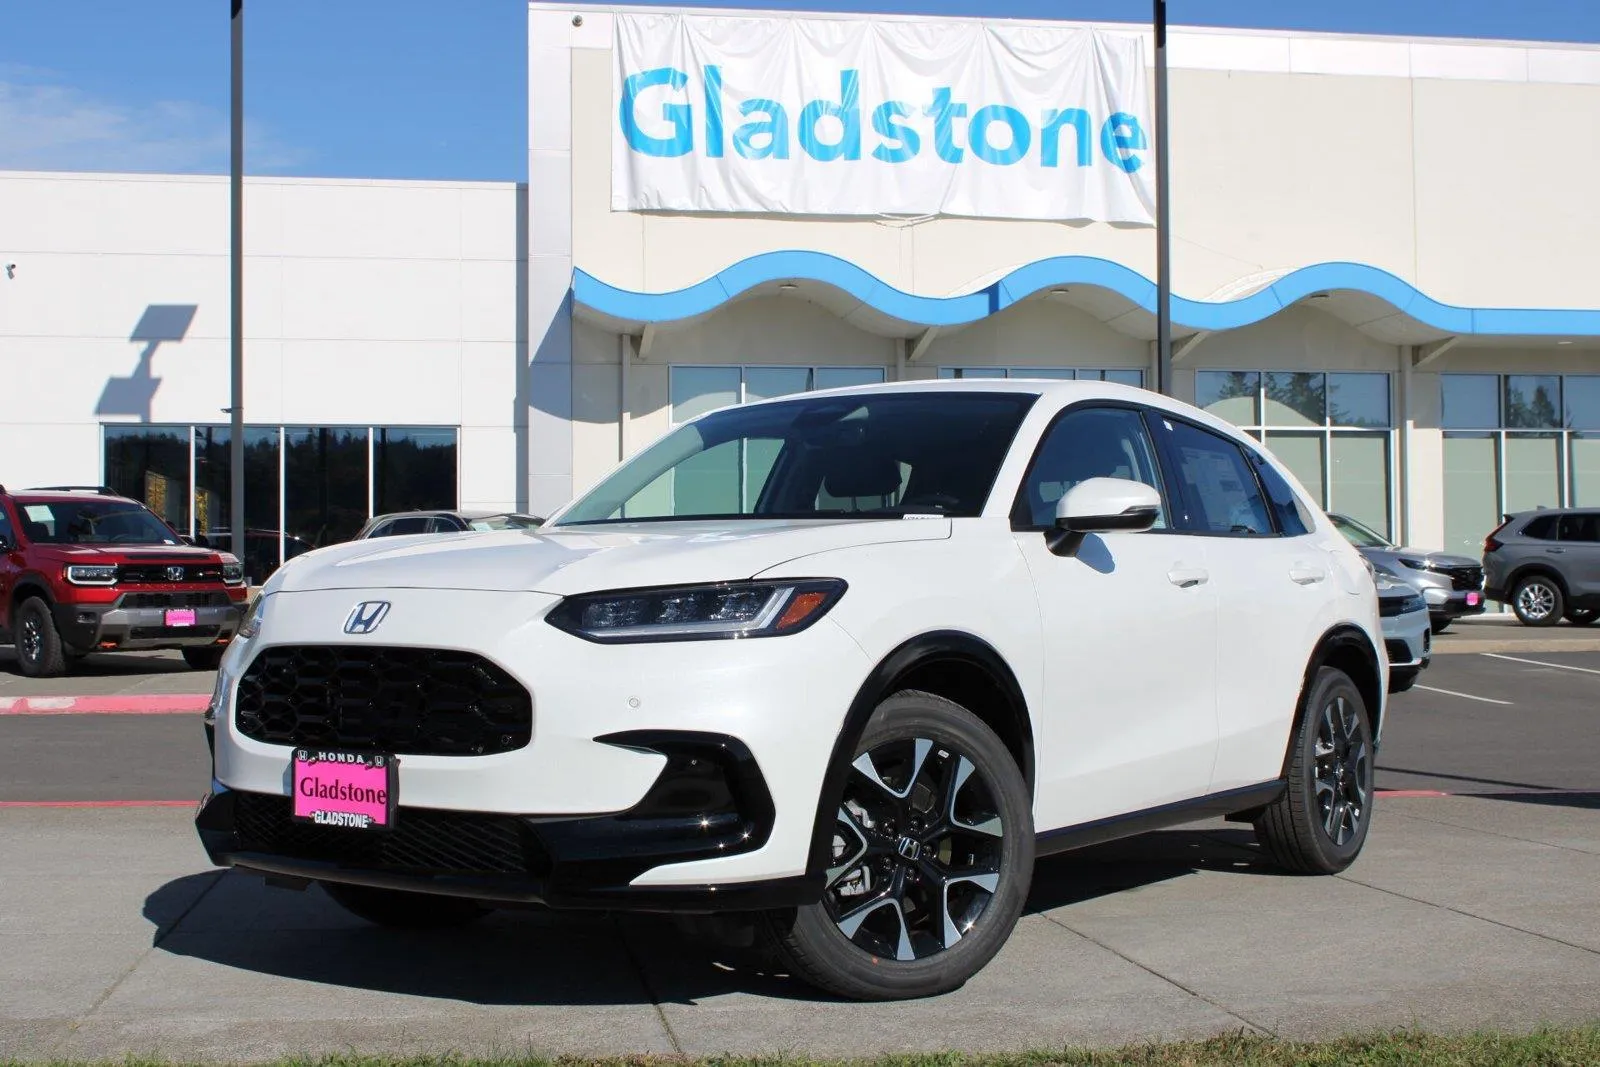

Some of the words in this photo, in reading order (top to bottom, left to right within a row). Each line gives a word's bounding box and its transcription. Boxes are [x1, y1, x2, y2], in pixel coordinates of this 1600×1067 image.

[618, 64, 1148, 174] Gladstone
[318, 751, 365, 764] HONDA
[300, 776, 387, 805] Gladstone
[314, 810, 368, 828] GLADSTONE
